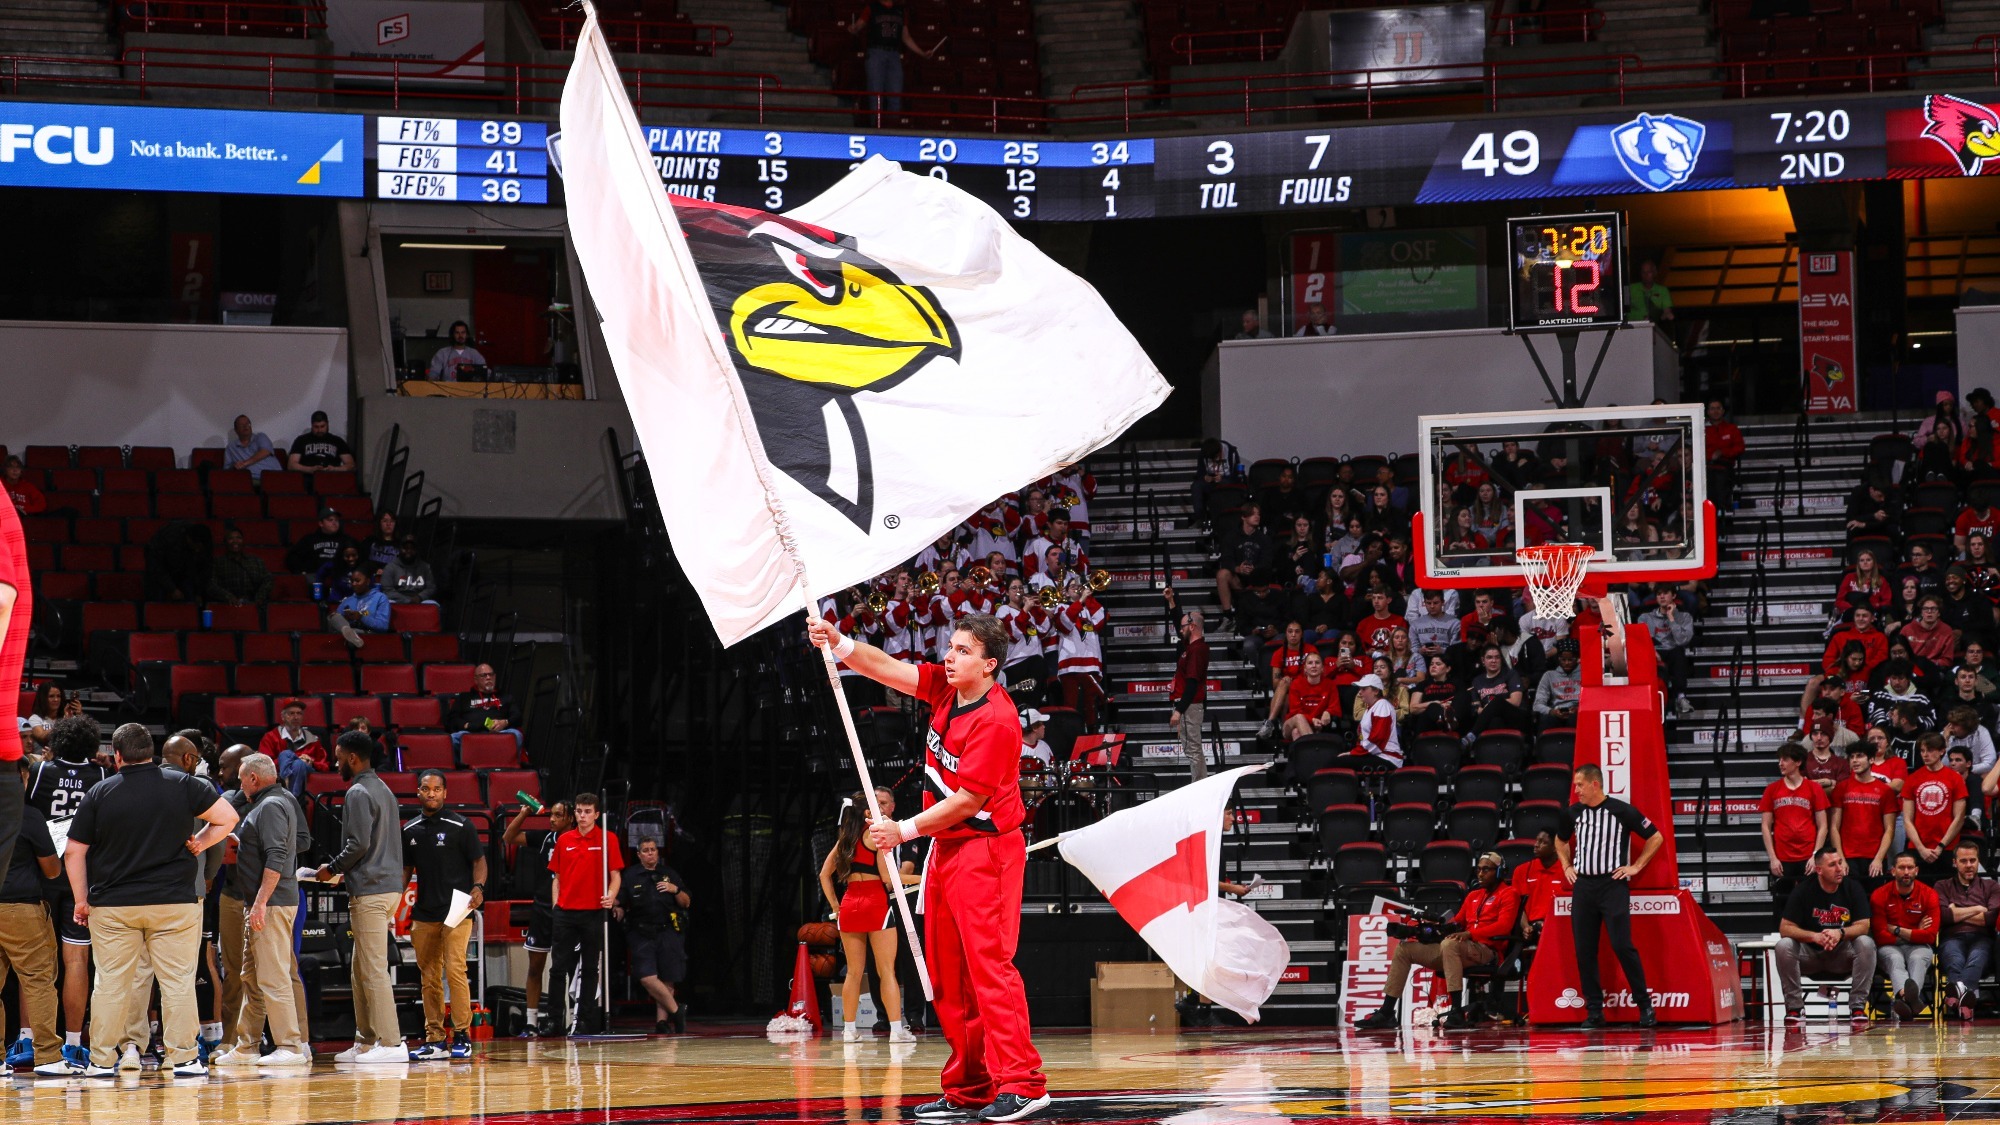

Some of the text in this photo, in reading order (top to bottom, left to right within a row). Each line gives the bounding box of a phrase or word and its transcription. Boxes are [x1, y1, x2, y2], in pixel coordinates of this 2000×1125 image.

[400, 120, 522, 144] FT% 89
[1770, 109, 1850, 144] 7:20
[0, 124, 115, 165] FCU
[130, 139, 278, 161] Not a bank. Better.
[648, 128, 1130, 165] PLAYER 3 5 20 25 34
[1206, 135, 1331, 176] 3 7
[1461, 130, 1540, 177] 49
[398, 148, 519, 173] FG% 41
[653, 157, 720, 180] POINTS
[758, 159, 788, 182] 15
[1006, 168, 1036, 192] 12
[1102, 168, 1121, 191] 4
[1780, 152, 1845, 180] 2ND
[391, 175, 521, 203] 3FG% 36
[663, 183, 1118, 218] OULS 3 3 1
[1200, 176, 1352, 209] TOL FOULS
[1391, 240, 1437, 263] OSF
[1543, 225, 1608, 256] 7:20
[1813, 257, 1832, 271] EXIT
[1304, 273, 1326, 304] 2
[1554, 260, 1600, 314] 12
[1539, 317, 1594, 325] DAKTRONICS
[398, 576, 425, 587] FILA
[1755, 729, 1788, 737] HELLER
[58, 778, 83, 789] BOLIS
[1722, 876, 1759, 885] HELLER
